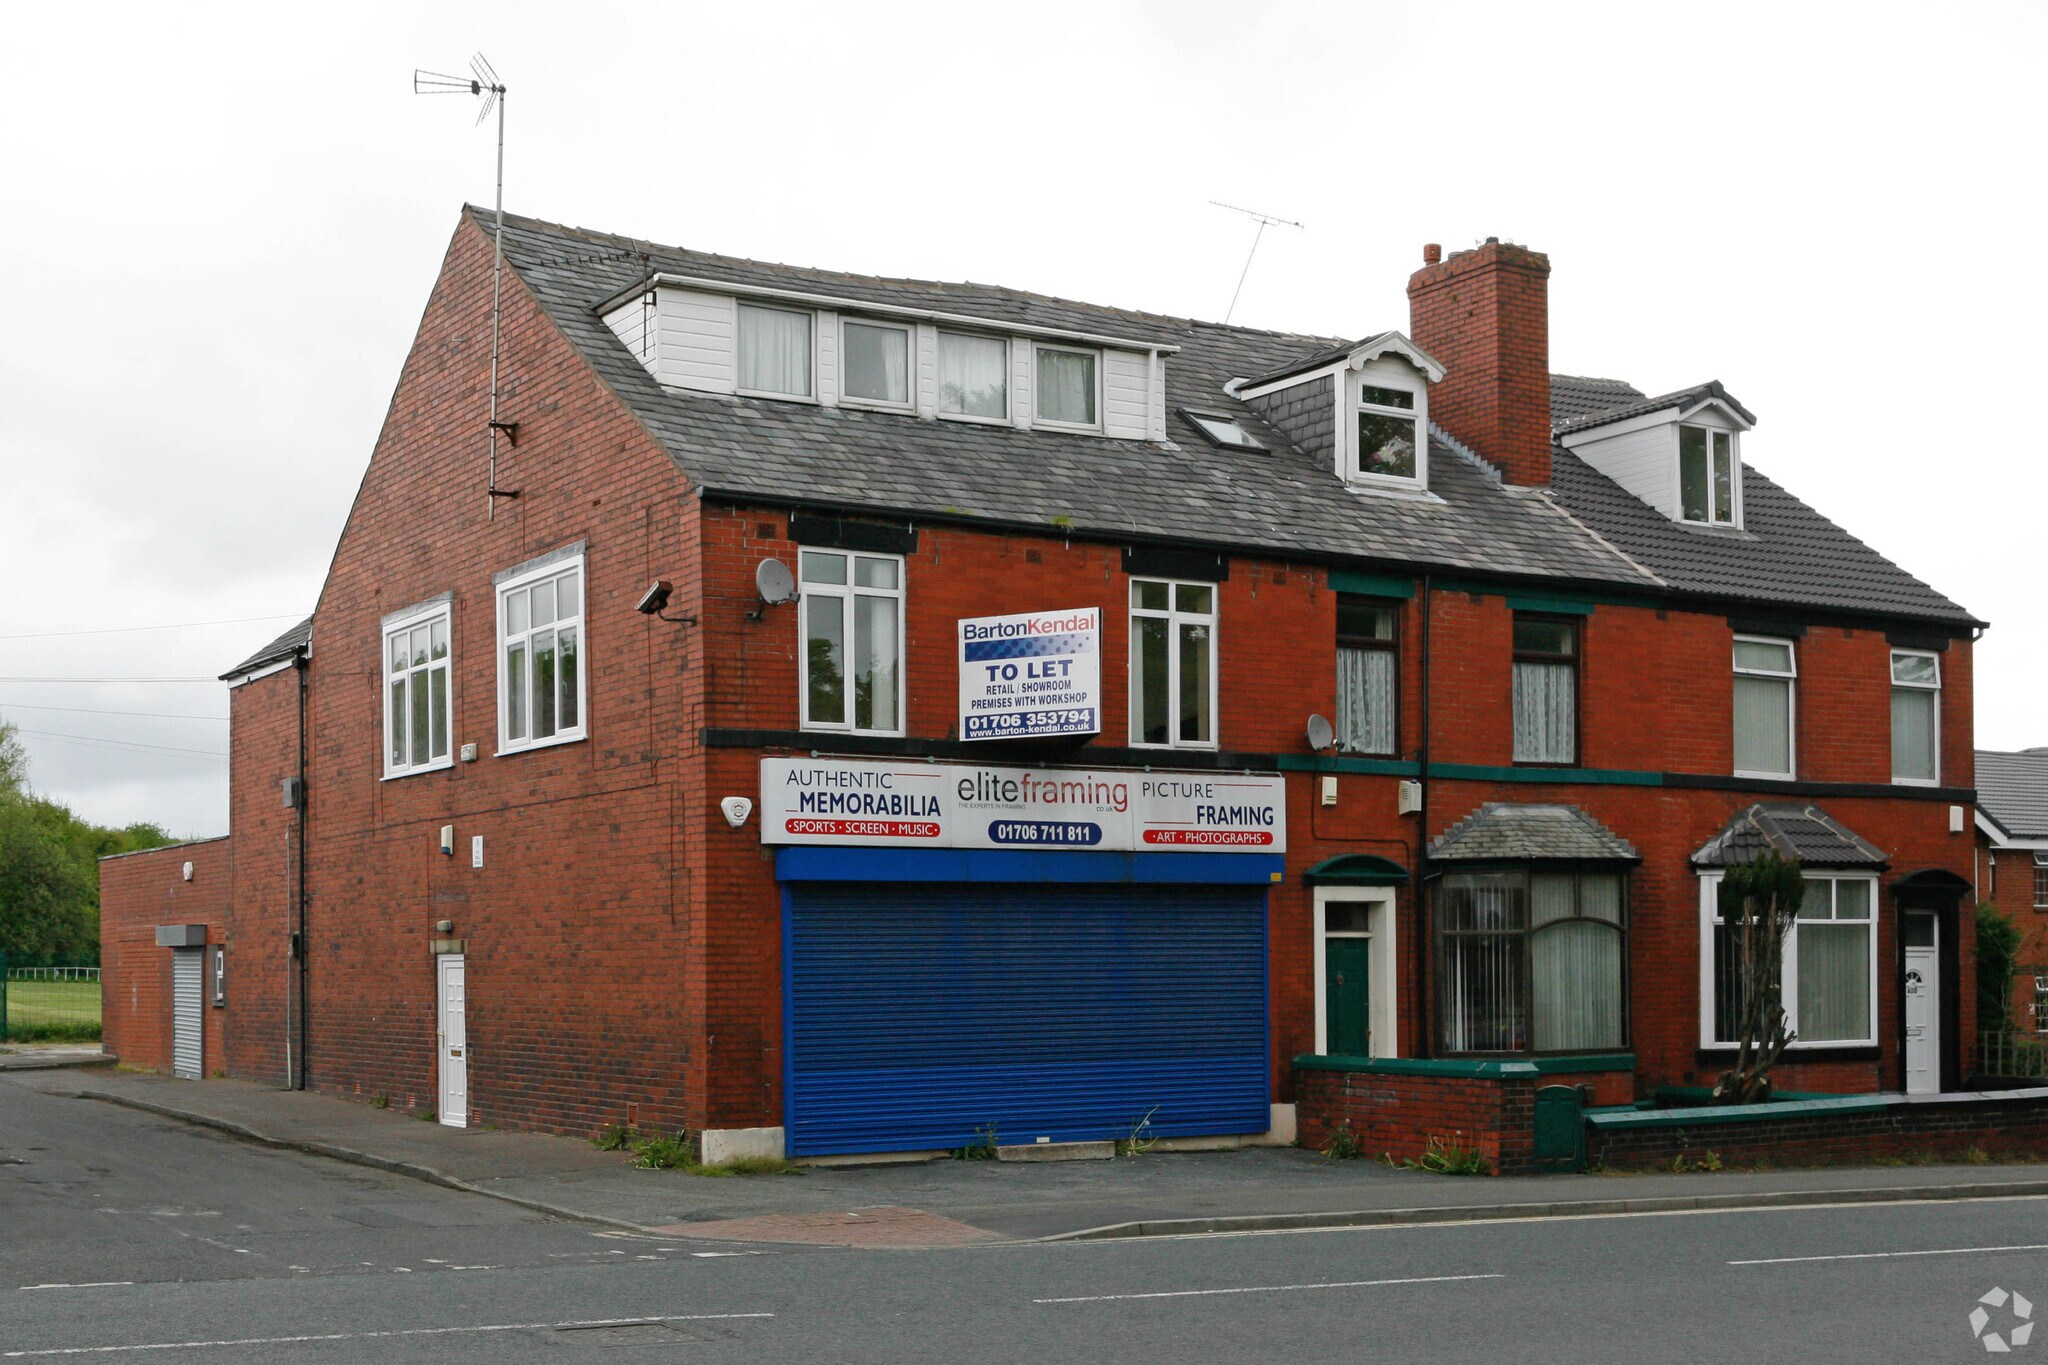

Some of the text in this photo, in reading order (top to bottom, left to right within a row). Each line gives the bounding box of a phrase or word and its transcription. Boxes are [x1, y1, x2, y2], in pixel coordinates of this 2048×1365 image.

[964, 614, 1094, 640] BartonKendal
[986, 660, 1073, 681] TO LET
[986, 685, 1014, 695] RETAIL
[1022, 680, 1071, 693] SHOWROOM
[972, 693, 1087, 709] PREMISES WITH WORKSHOP
[969, 710, 1090, 729] 01706 353794
[970, 722, 1089, 737] www.barton-kendal.co.uk
[787, 770, 892, 788] AUTHENTIC
[958, 772, 1128, 812] eliteframing
[1143, 782, 1213, 798] PICTURE
[800, 792, 941, 816] MEMORABILIA
[1197, 806, 1273, 825] FRAMING
[793, 821, 933, 835] SPORTS SCREEN MUSIC
[998, 825, 1090, 841] 01706 711 811
[1157, 832, 1261, 843] ART PHOTOGRAPHS
